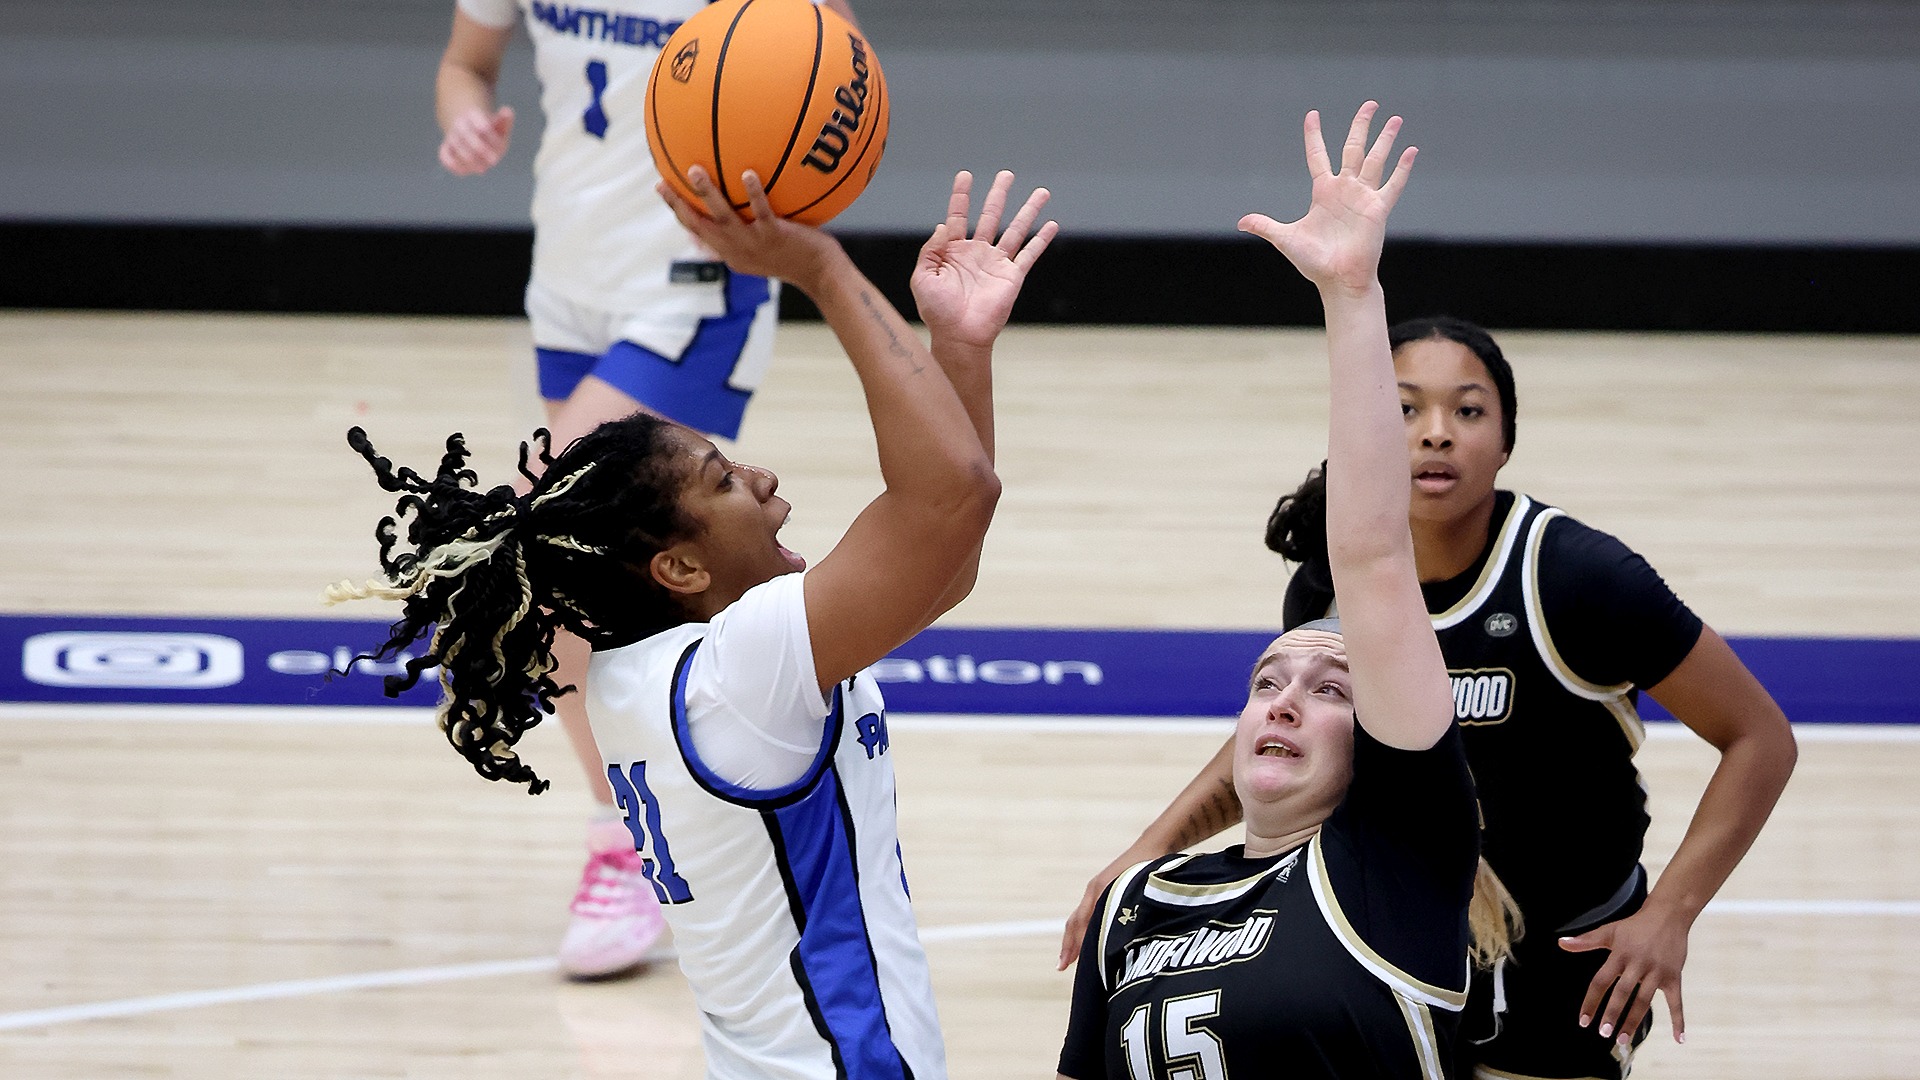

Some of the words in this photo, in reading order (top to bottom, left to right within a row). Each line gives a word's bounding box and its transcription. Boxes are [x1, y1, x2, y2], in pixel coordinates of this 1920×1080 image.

[583, 60, 609, 140] 1
[801, 33, 869, 174] Wilson
[1121, 988, 1229, 1080] 15
